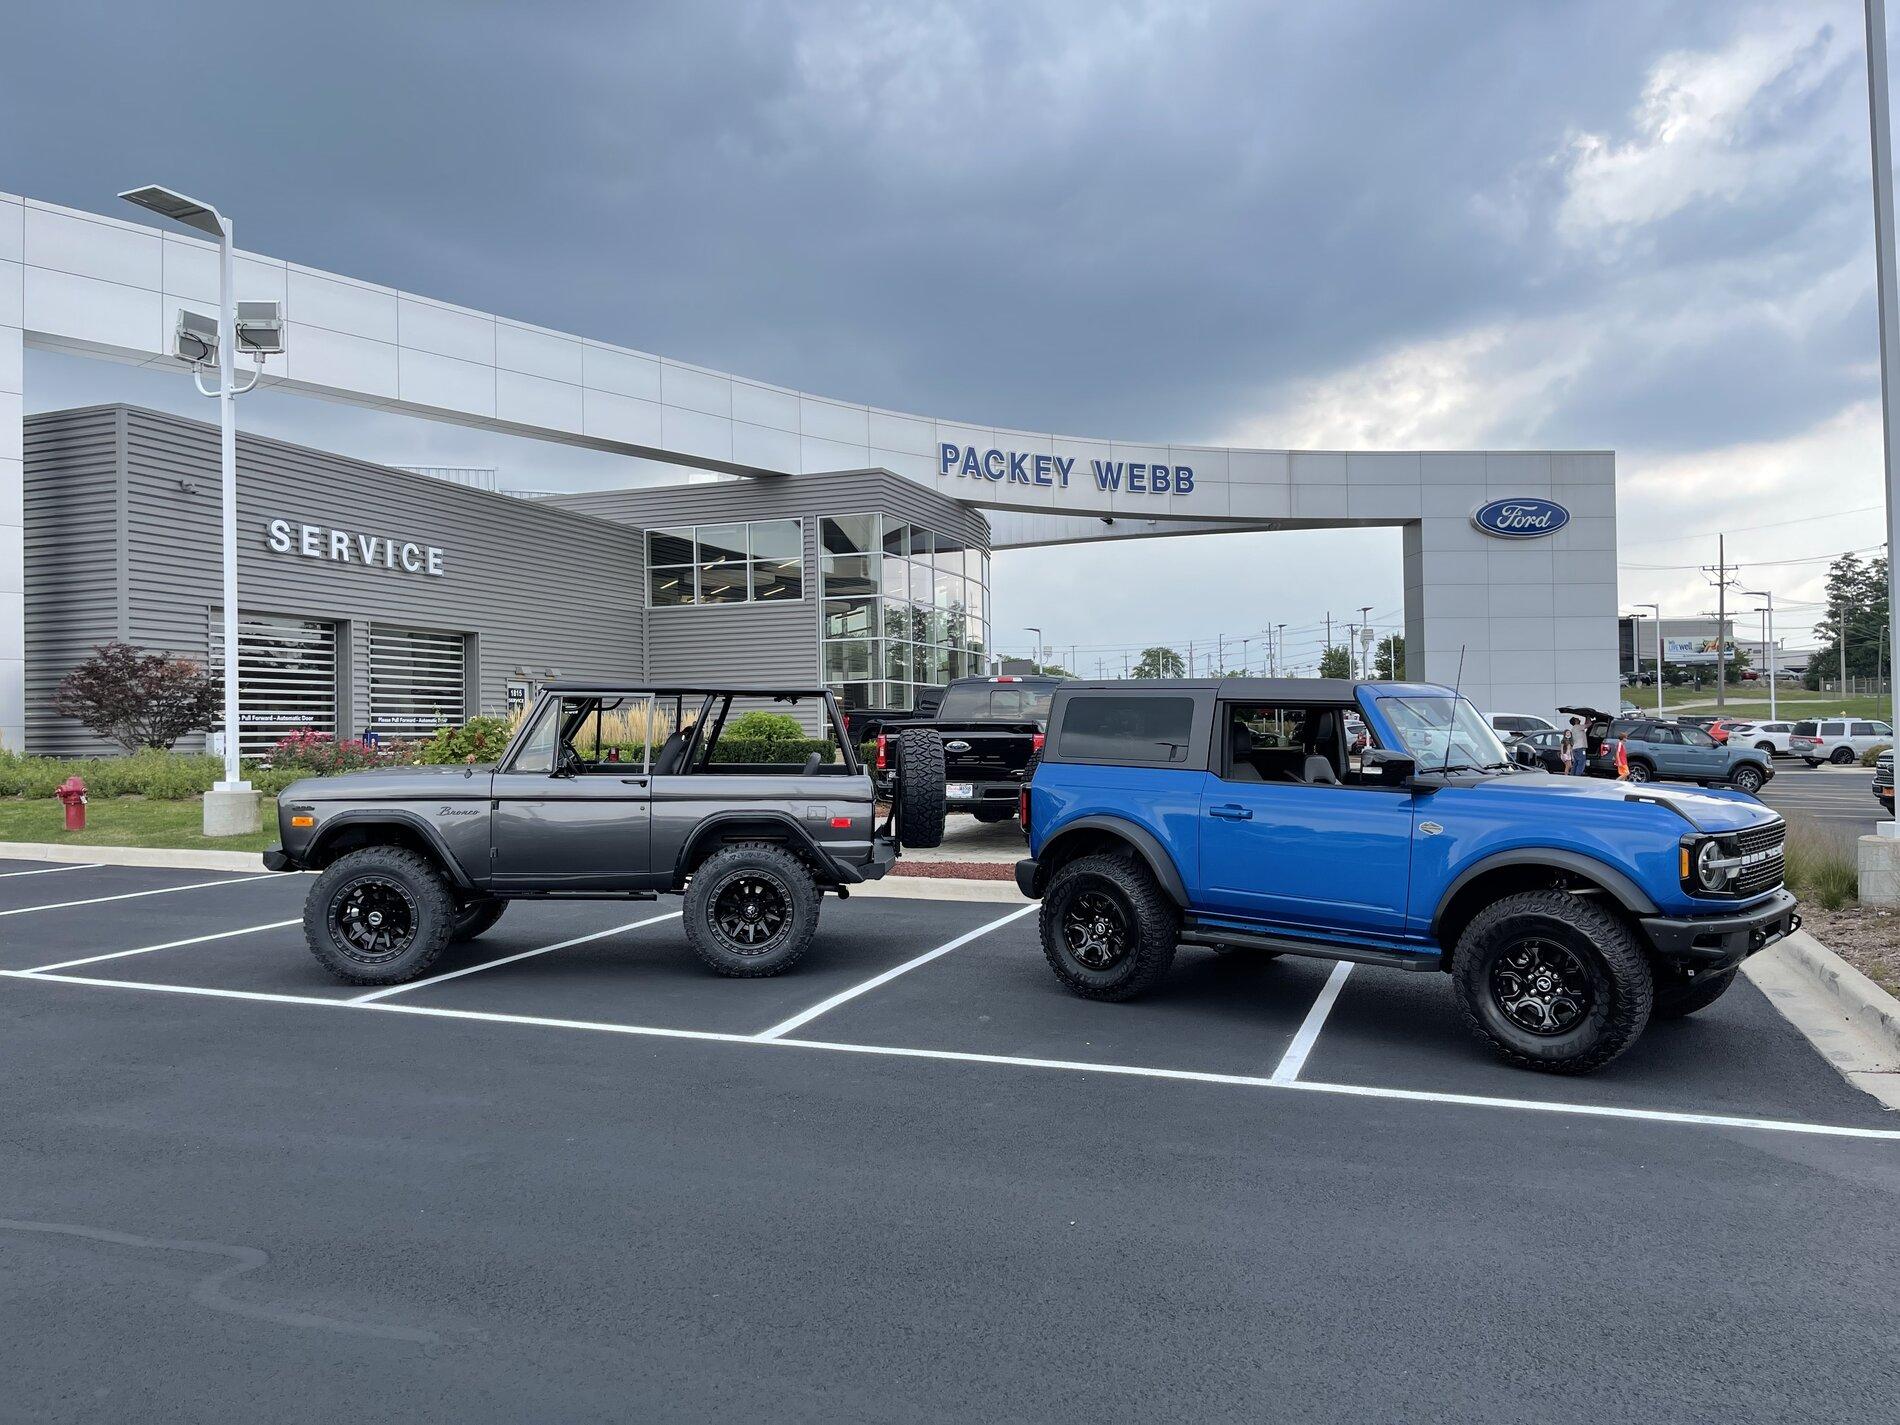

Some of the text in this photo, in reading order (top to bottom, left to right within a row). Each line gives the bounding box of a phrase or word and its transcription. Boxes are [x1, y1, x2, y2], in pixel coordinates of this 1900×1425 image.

[939, 442, 1196, 495] PACKEY WEBB
[1496, 504, 1552, 529] Ford
[268, 518, 444, 576] SERVICE
[436, 806, 480, 817] Bronco
